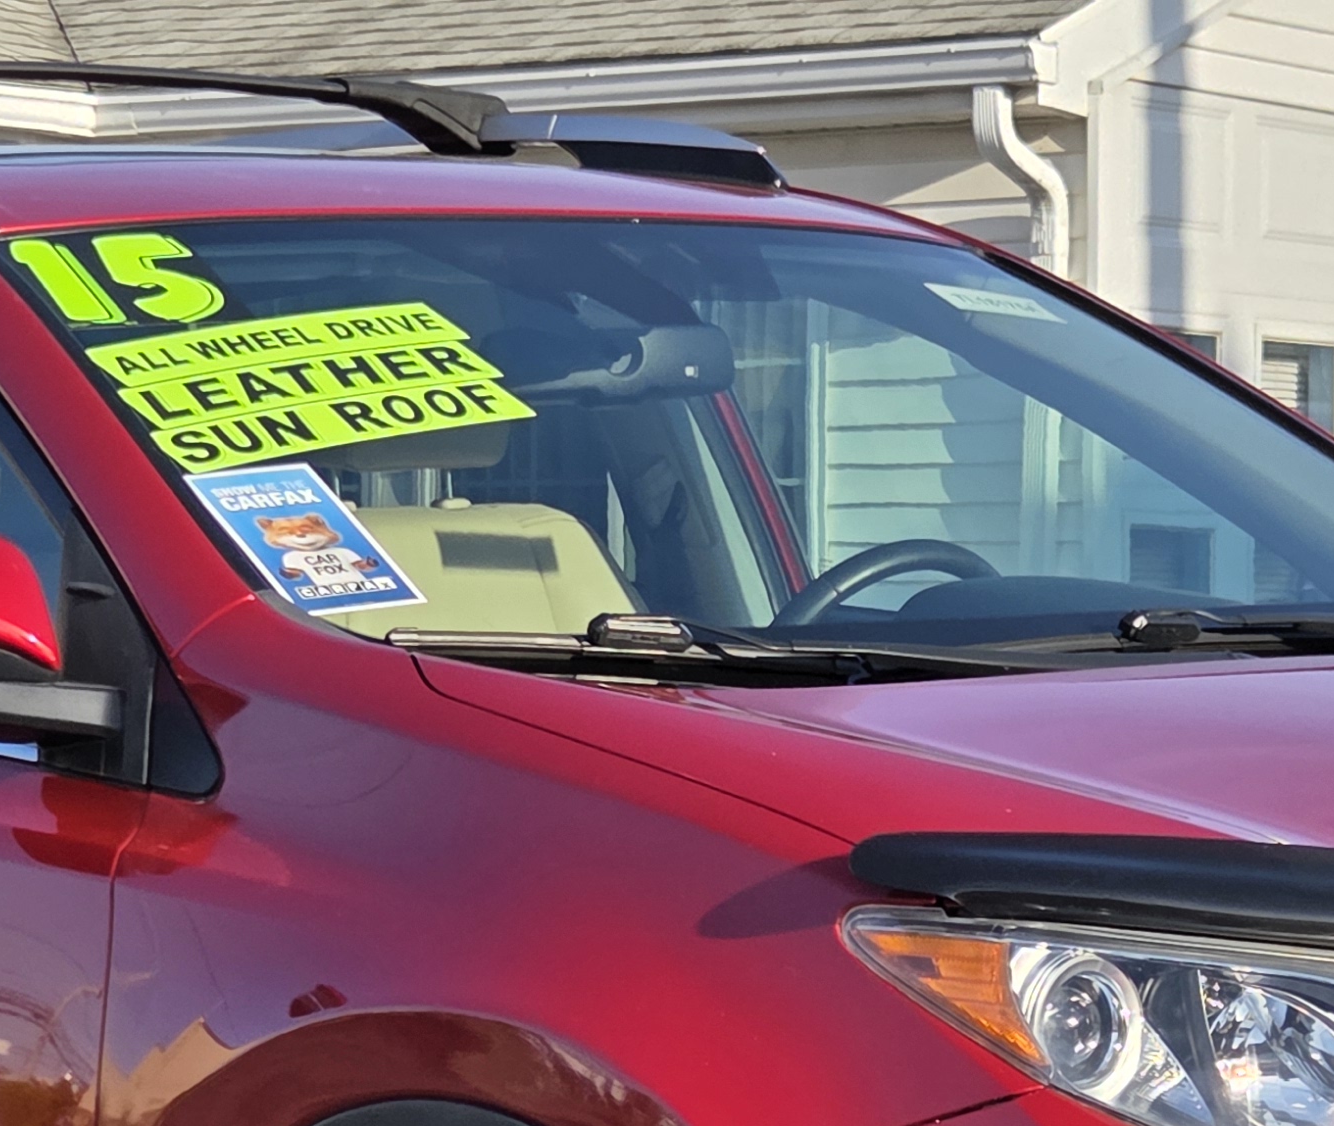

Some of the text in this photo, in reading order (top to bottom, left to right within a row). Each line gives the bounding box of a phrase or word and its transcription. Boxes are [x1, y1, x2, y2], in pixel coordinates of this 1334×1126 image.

[9, 232, 225, 325] 15
[116, 311, 444, 377] ALL WHEEL DRIVE
[138, 344, 480, 423] LEATHER
[170, 383, 501, 466] SUN ROOF
[210, 484, 258, 498] SHOW
[219, 488, 323, 512] CARFAX
[304, 554, 342, 566] CAR
[312, 563, 349, 576] FOX
